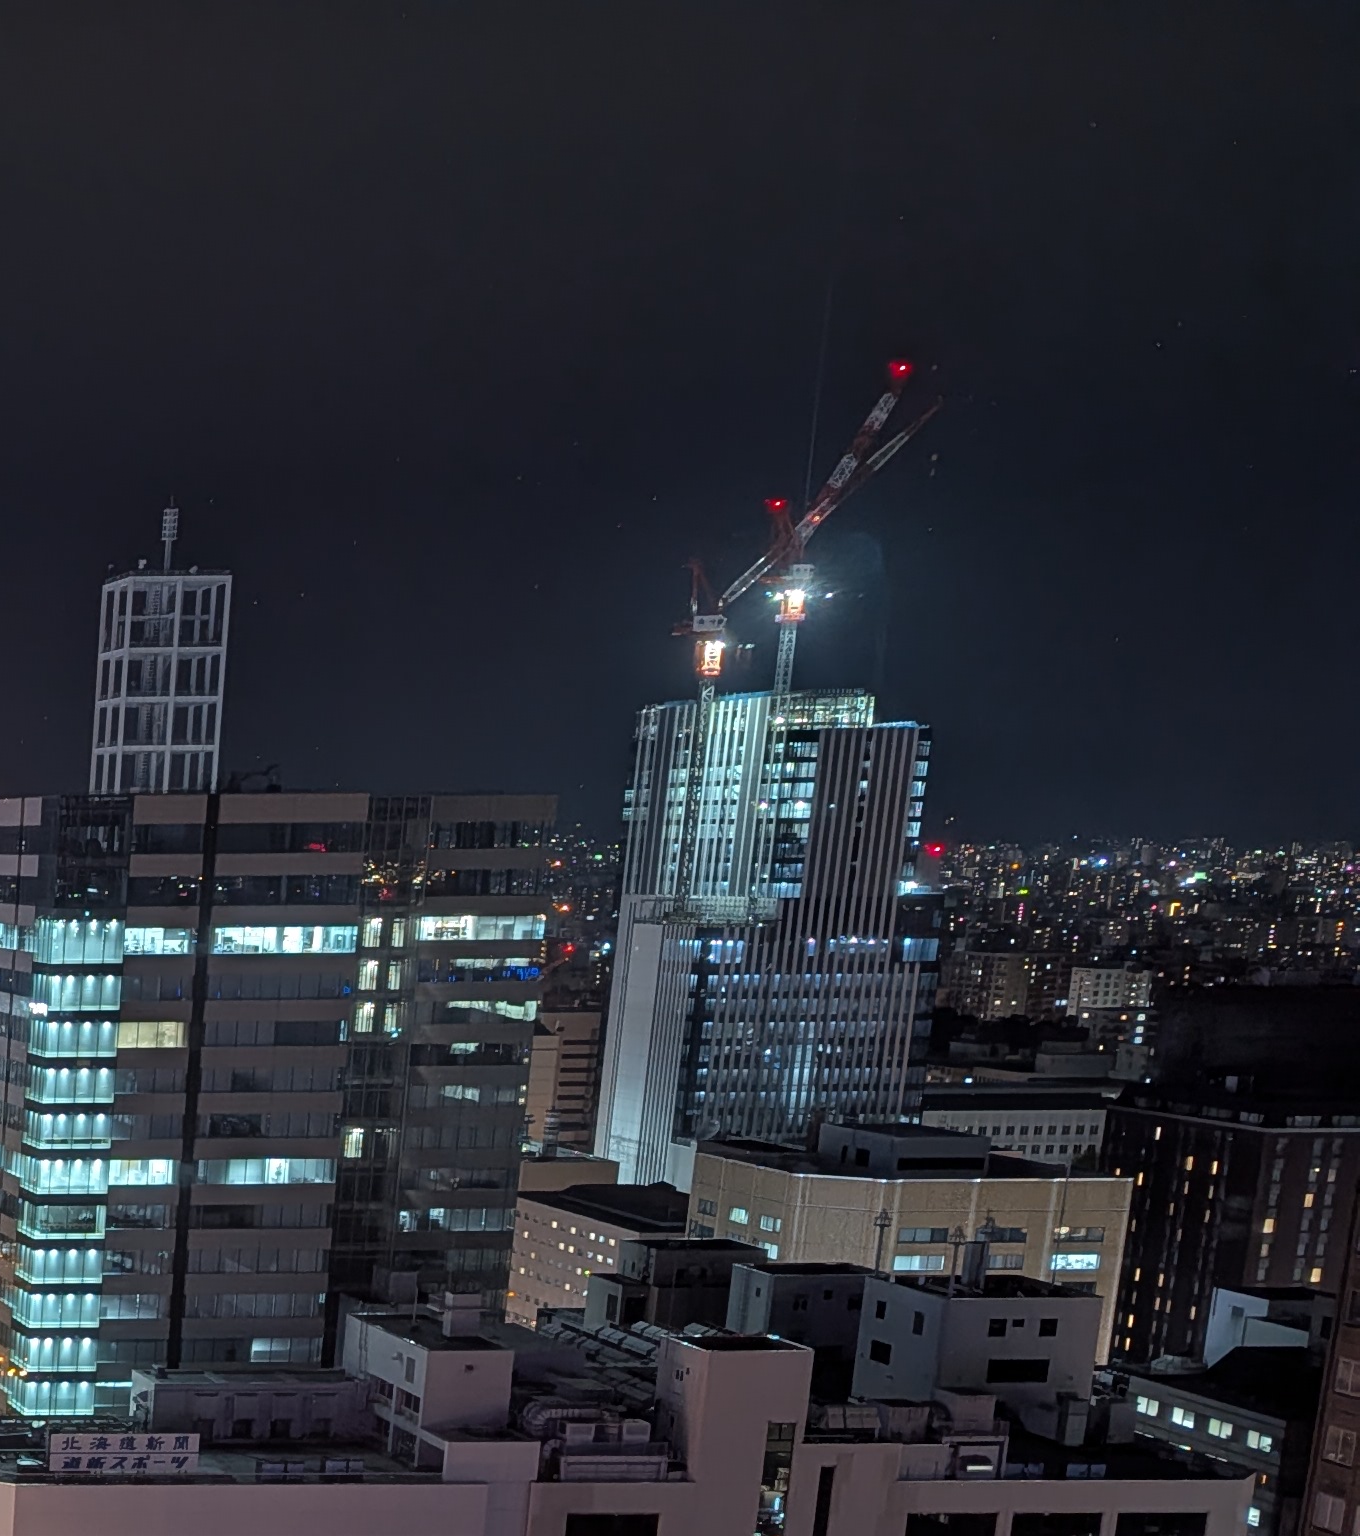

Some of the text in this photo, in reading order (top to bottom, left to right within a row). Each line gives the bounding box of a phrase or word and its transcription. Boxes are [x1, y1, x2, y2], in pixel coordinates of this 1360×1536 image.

[62, 1436, 189, 1450] 北海道新聞
[61, 1455, 189, 1469] 道新スポーツ
